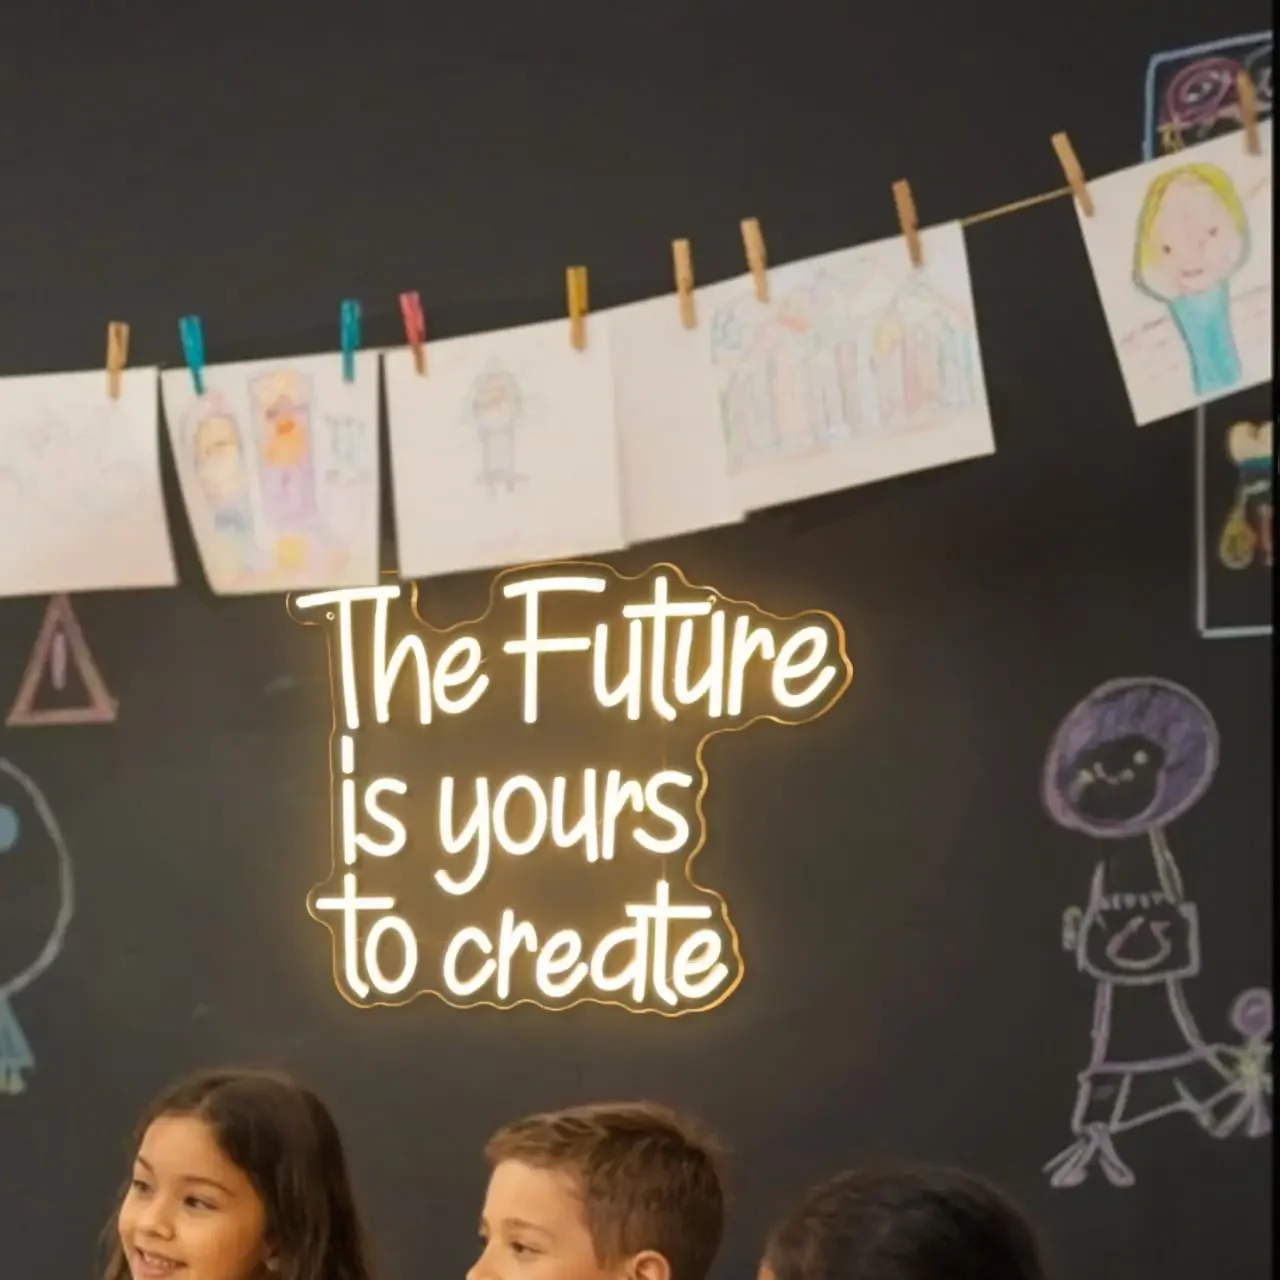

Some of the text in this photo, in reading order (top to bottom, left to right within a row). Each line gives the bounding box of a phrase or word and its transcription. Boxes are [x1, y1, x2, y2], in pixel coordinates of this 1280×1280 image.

[295, 575, 837, 730] The Future
[341, 735, 693, 896] is yours
[315, 872, 729, 1006] to create
